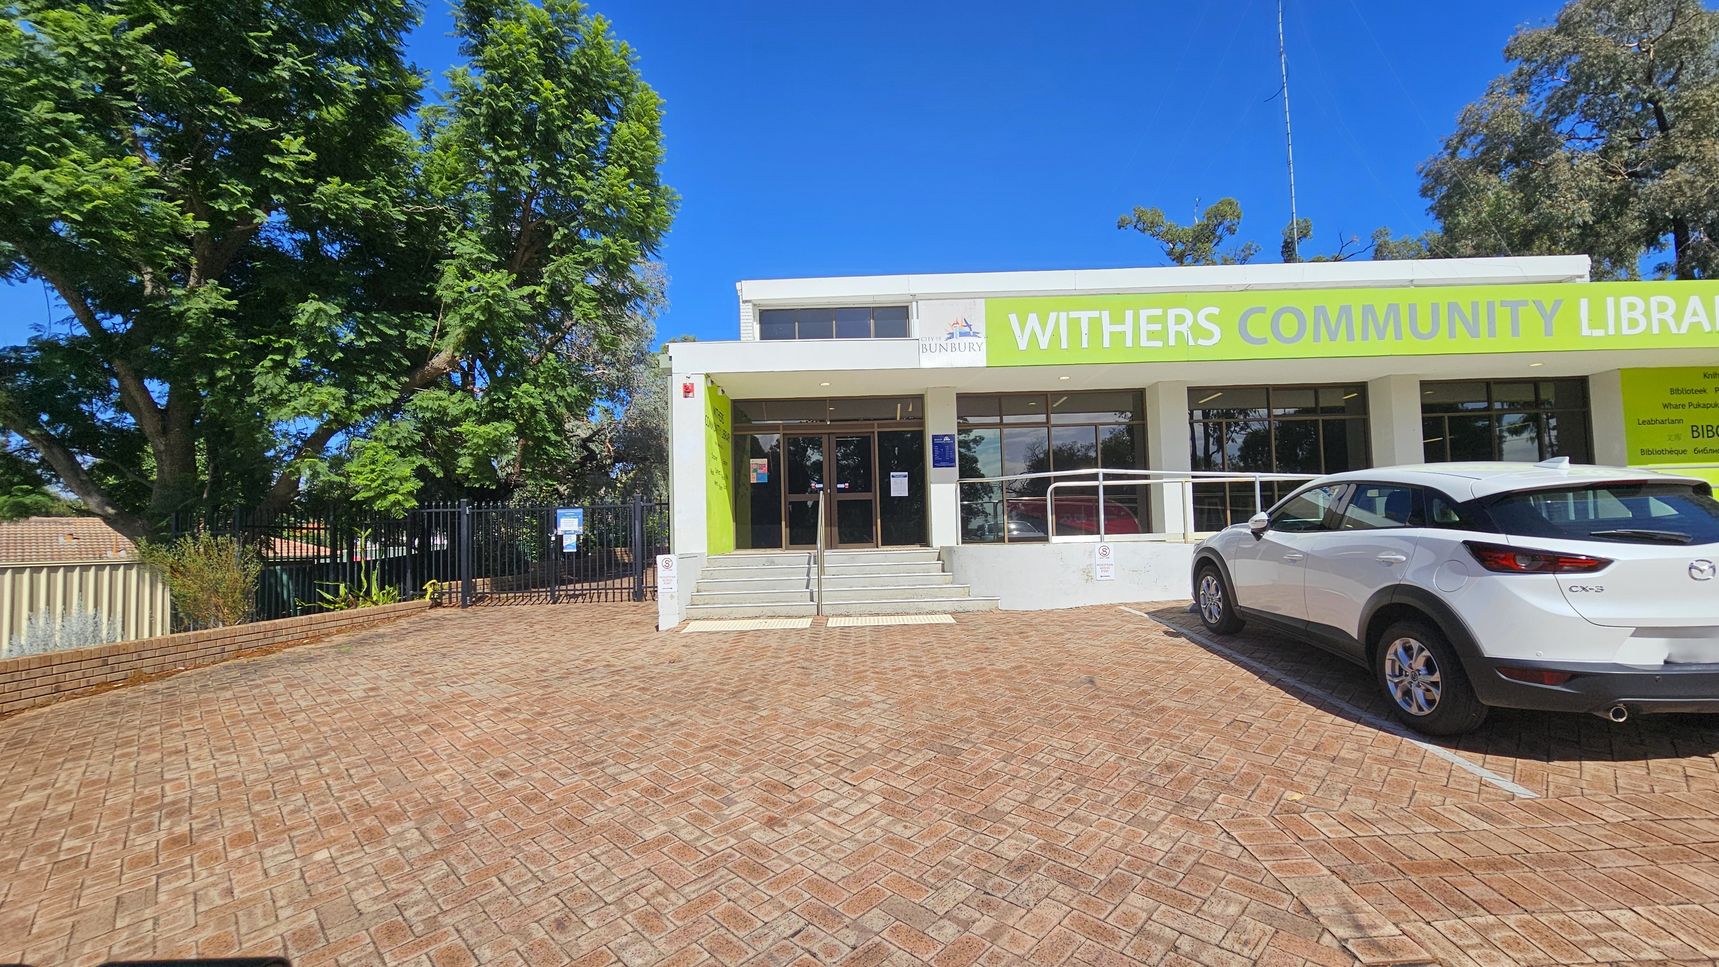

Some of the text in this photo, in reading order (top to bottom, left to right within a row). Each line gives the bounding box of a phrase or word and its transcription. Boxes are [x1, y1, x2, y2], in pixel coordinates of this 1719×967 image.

[1008, 306, 1221, 350] WITHERS
[1238, 299, 1563, 346] COMMUNITY
[921, 342, 984, 353] BUNBURY
[1669, 387, 1707, 395] Biblioteek
[1569, 585, 1605, 593] CX-3
